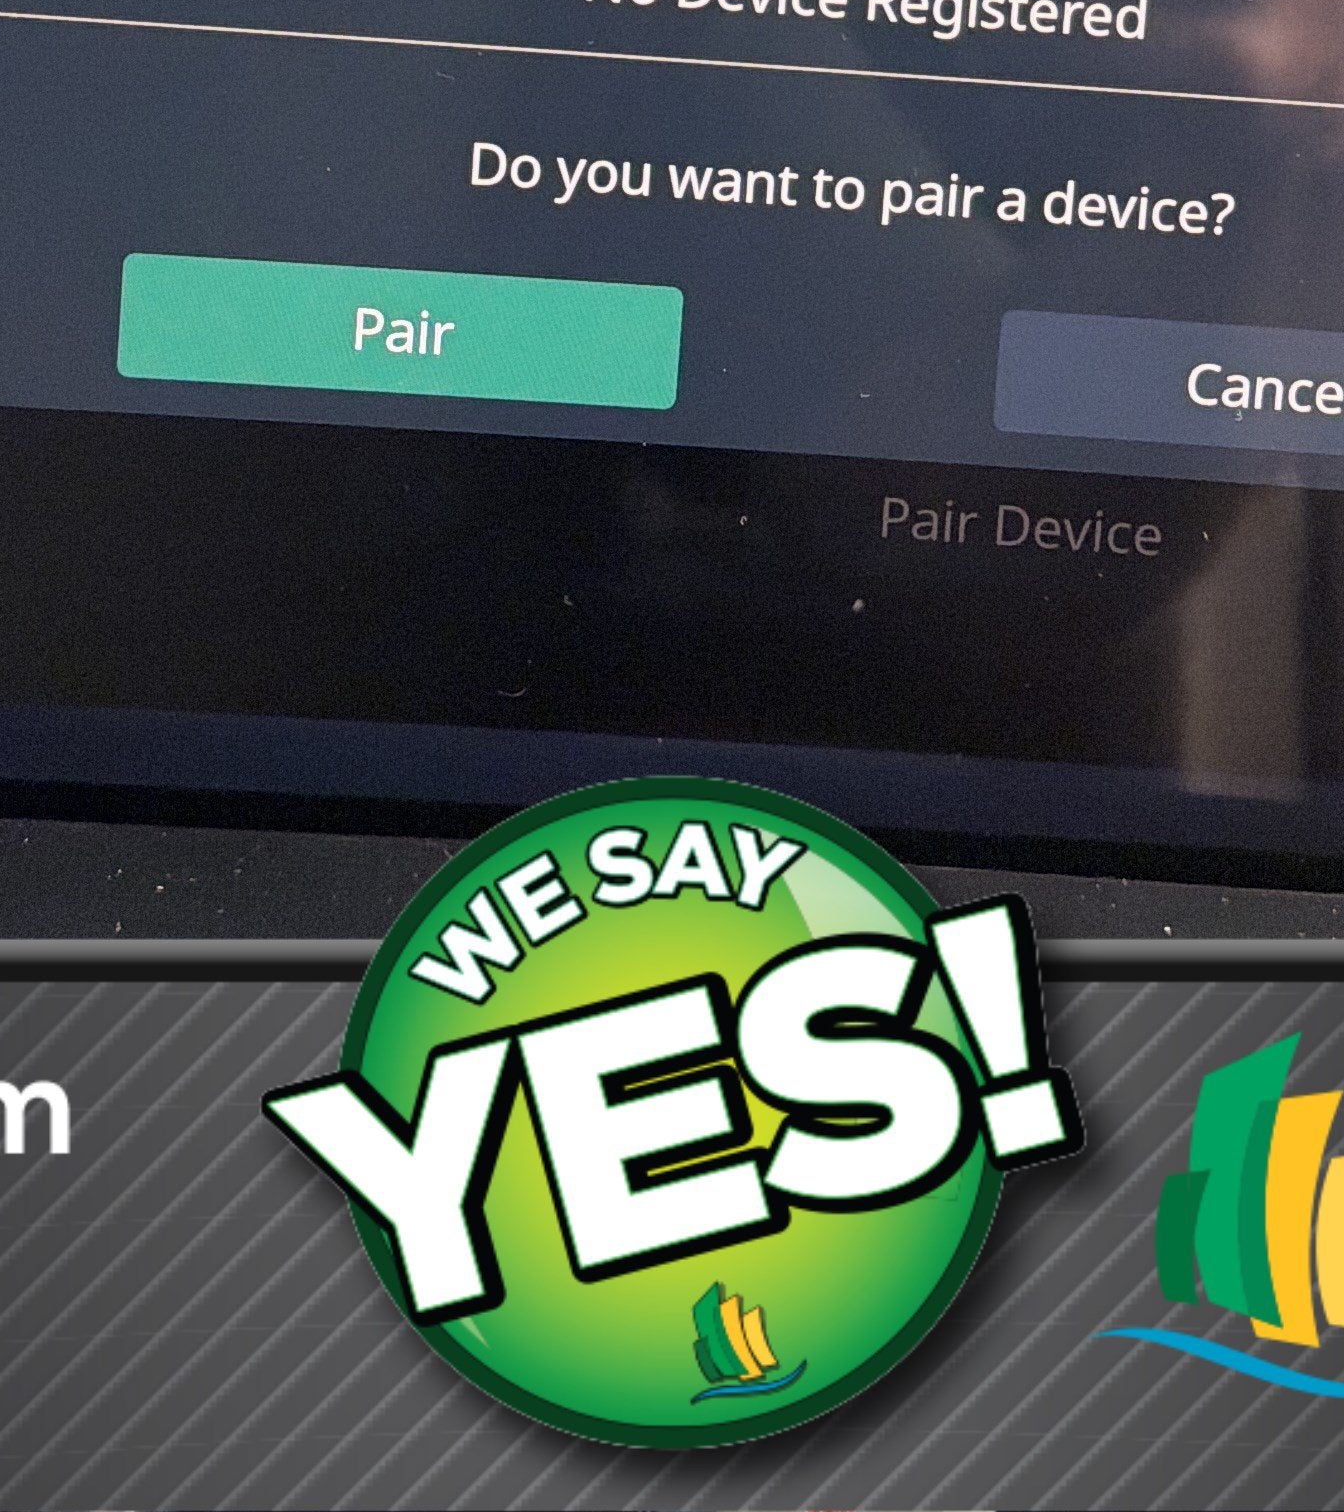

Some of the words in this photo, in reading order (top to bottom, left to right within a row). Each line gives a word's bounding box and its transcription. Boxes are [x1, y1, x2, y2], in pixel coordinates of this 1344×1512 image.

[470, 141, 542, 189] Do
[553, 156, 652, 205] you
[668, 164, 799, 207] want
[813, 168, 866, 211] to
[881, 173, 985, 226] pair
[996, 187, 1027, 222] a
[1043, 179, 1236, 236] device?
[354, 306, 455, 356] Pair
[881, 496, 979, 544] Pair
[995, 504, 1162, 557] Device
